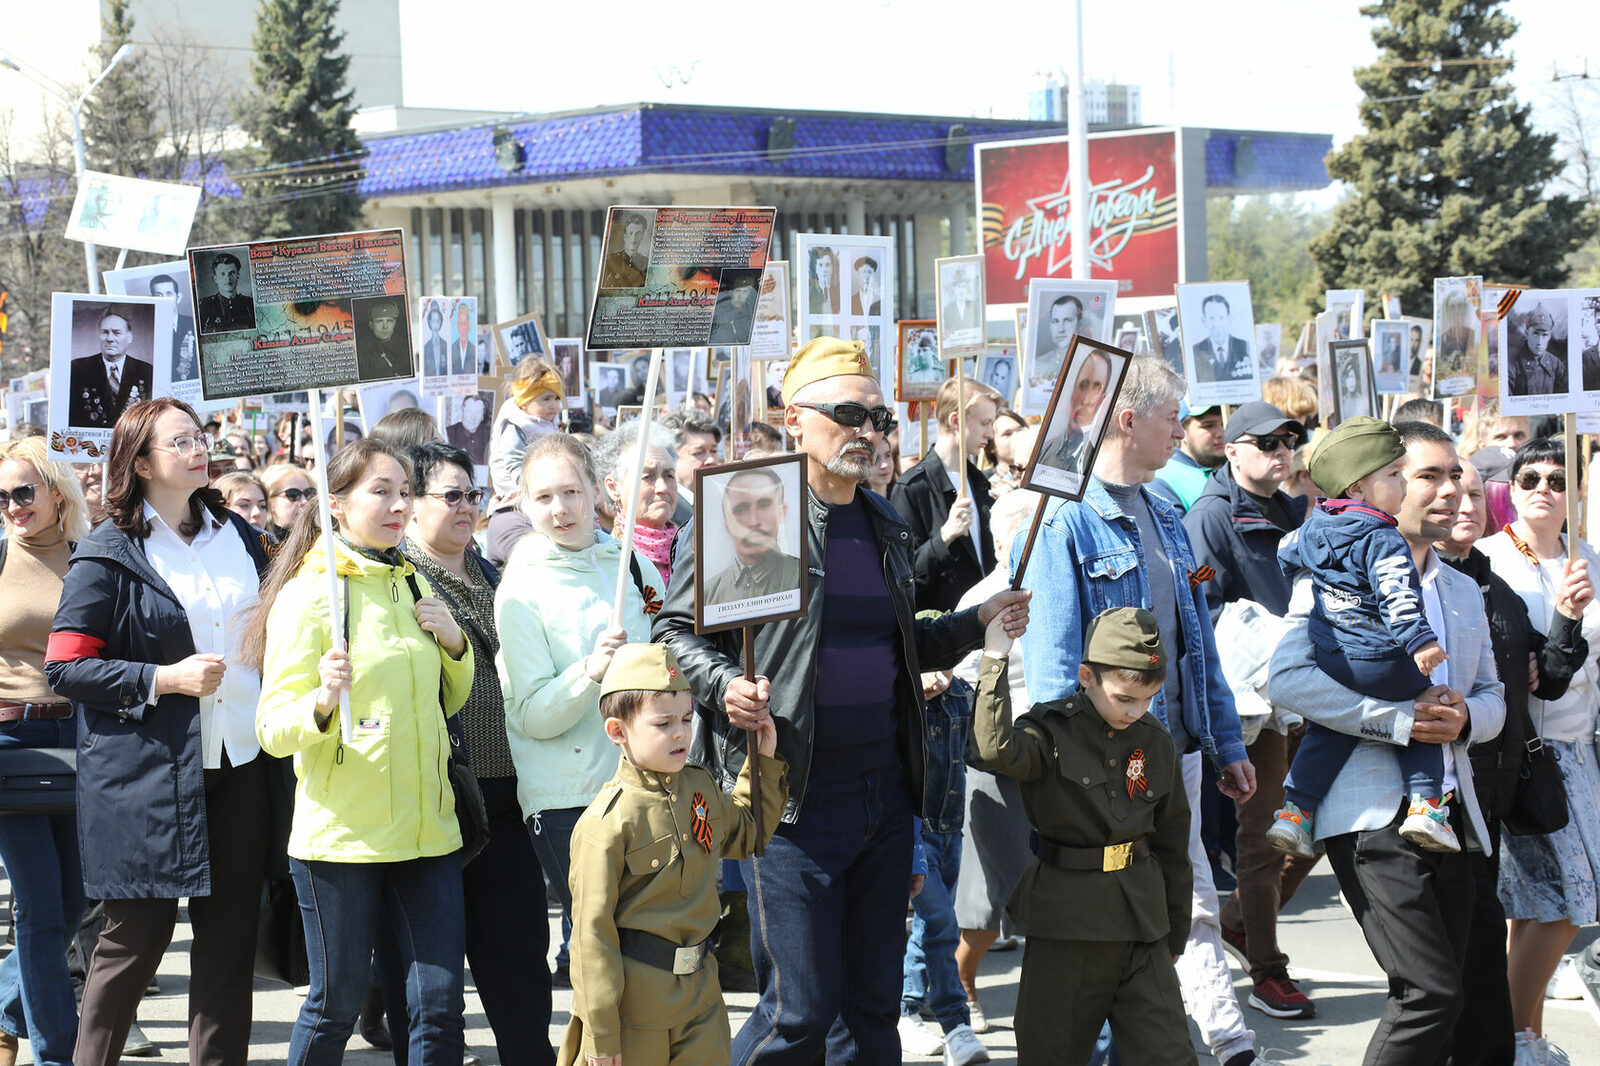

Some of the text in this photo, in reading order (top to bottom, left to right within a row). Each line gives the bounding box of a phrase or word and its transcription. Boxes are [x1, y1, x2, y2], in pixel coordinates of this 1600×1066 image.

[250, 249, 273, 259] Вовк
[319, 242, 353, 254] Виктор
[354, 238, 399, 249] Павлович
[1004, 216, 1024, 260] С
